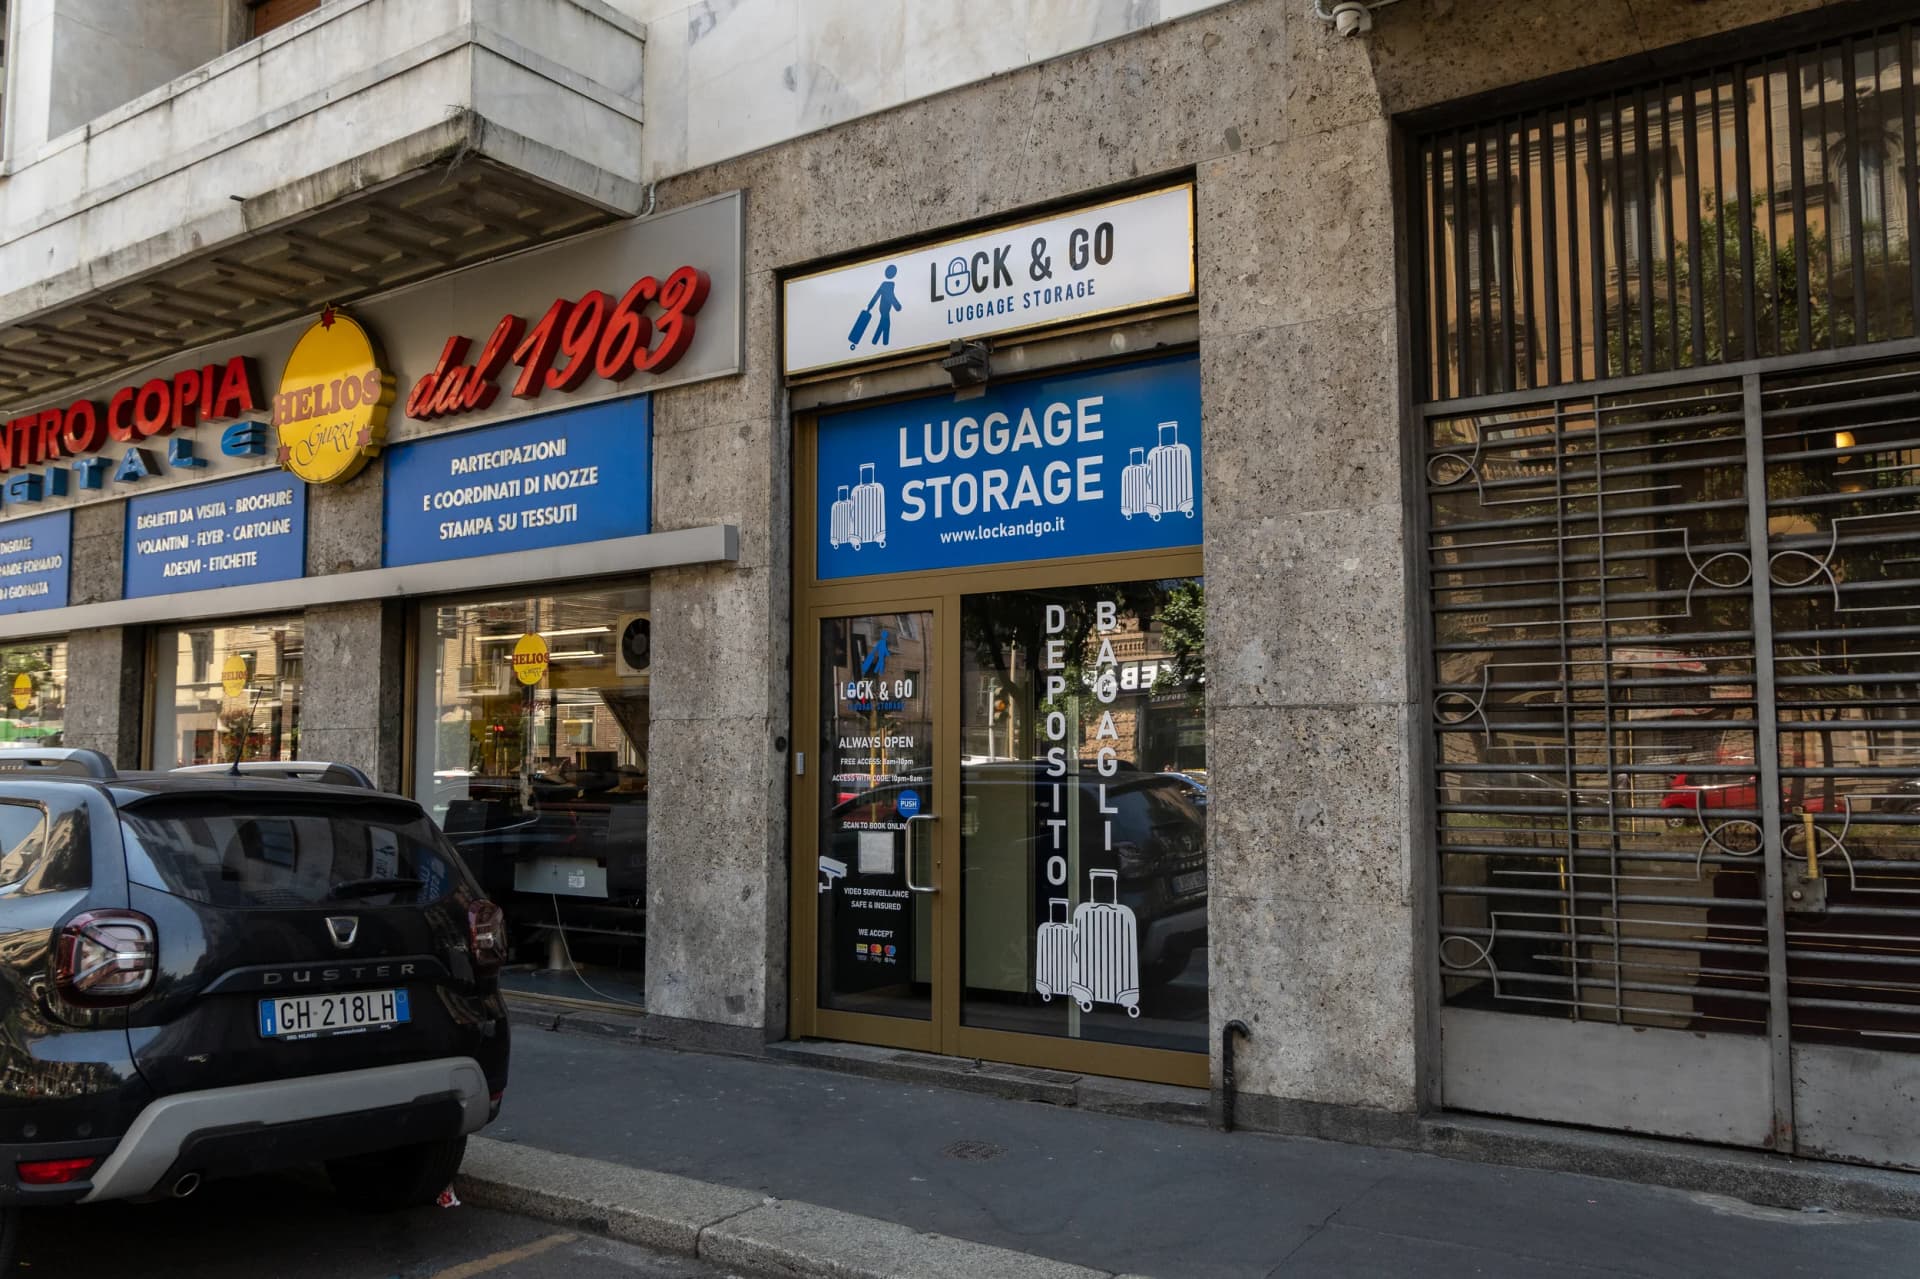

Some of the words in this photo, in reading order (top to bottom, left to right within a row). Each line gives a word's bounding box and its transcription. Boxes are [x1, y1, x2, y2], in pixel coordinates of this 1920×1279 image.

[930, 244, 1013, 303] LOCK
[1030, 237, 1053, 281] &
[1069, 222, 1114, 270] GO
[947, 296, 1014, 324] LUGGAGE
[1023, 279, 1095, 308] STORAGE
[406, 314, 526, 420] dal
[511, 265, 710, 399] 1963
[107, 355, 262, 443] COPIA
[272, 368, 382, 427] HELIOS
[899, 395, 1104, 468] LUGGAGE
[450, 438, 567, 476] PARTECIPAZIONI
[423, 494, 431, 512] E
[434, 478, 520, 509] COORDINATI
[525, 476, 540, 495] DI
[544, 466, 598, 491] NOZZE
[900, 455, 1104, 522] STORAGE
[136, 510, 178, 530] BIGLIETTI
[179, 508, 194, 523] DA
[196, 502, 227, 519] VISITA
[236, 490, 293, 513] BROCHURE
[439, 517, 493, 540] STAMPA
[498, 513, 517, 531] SU
[521, 504, 578, 528] TESSUTI
[137, 535, 189, 555] VOLANTINI
[197, 529, 224, 546] FLYER
[233, 519, 291, 541] CARTOLINE
[940, 517, 1065, 544] www.lockandgo.it
[163, 559, 200, 577] ADESIVI
[209, 551, 257, 571] ETICHETTE
[512, 652, 550, 665] HELIOS
[879, 682, 889, 700] &
[895, 678, 913, 698] GO
[839, 736, 880, 749] ALWAYS
[884, 736, 914, 748] OPEN
[1096, 601, 1119, 850] BAGAGLI
[1045, 604, 1067, 886] DEPOSITO
[832, 774, 855, 782] ACCESS
[901, 800, 916, 808] PUSH
[843, 821, 860, 829] SCAN
[860, 821, 868, 829] TO
[869, 822, 886, 830] BOOK
[887, 822, 910, 830] ONLIN
[843, 887, 862, 896] VIDEO
[862, 888, 909, 899] SURVEILLANCE
[851, 900, 867, 909] SAFE
[874, 902, 901, 911] INSURED
[858, 928, 868, 936] WE
[869, 929, 894, 939] ACCEPT
[263, 964, 416, 985] DUSTER
